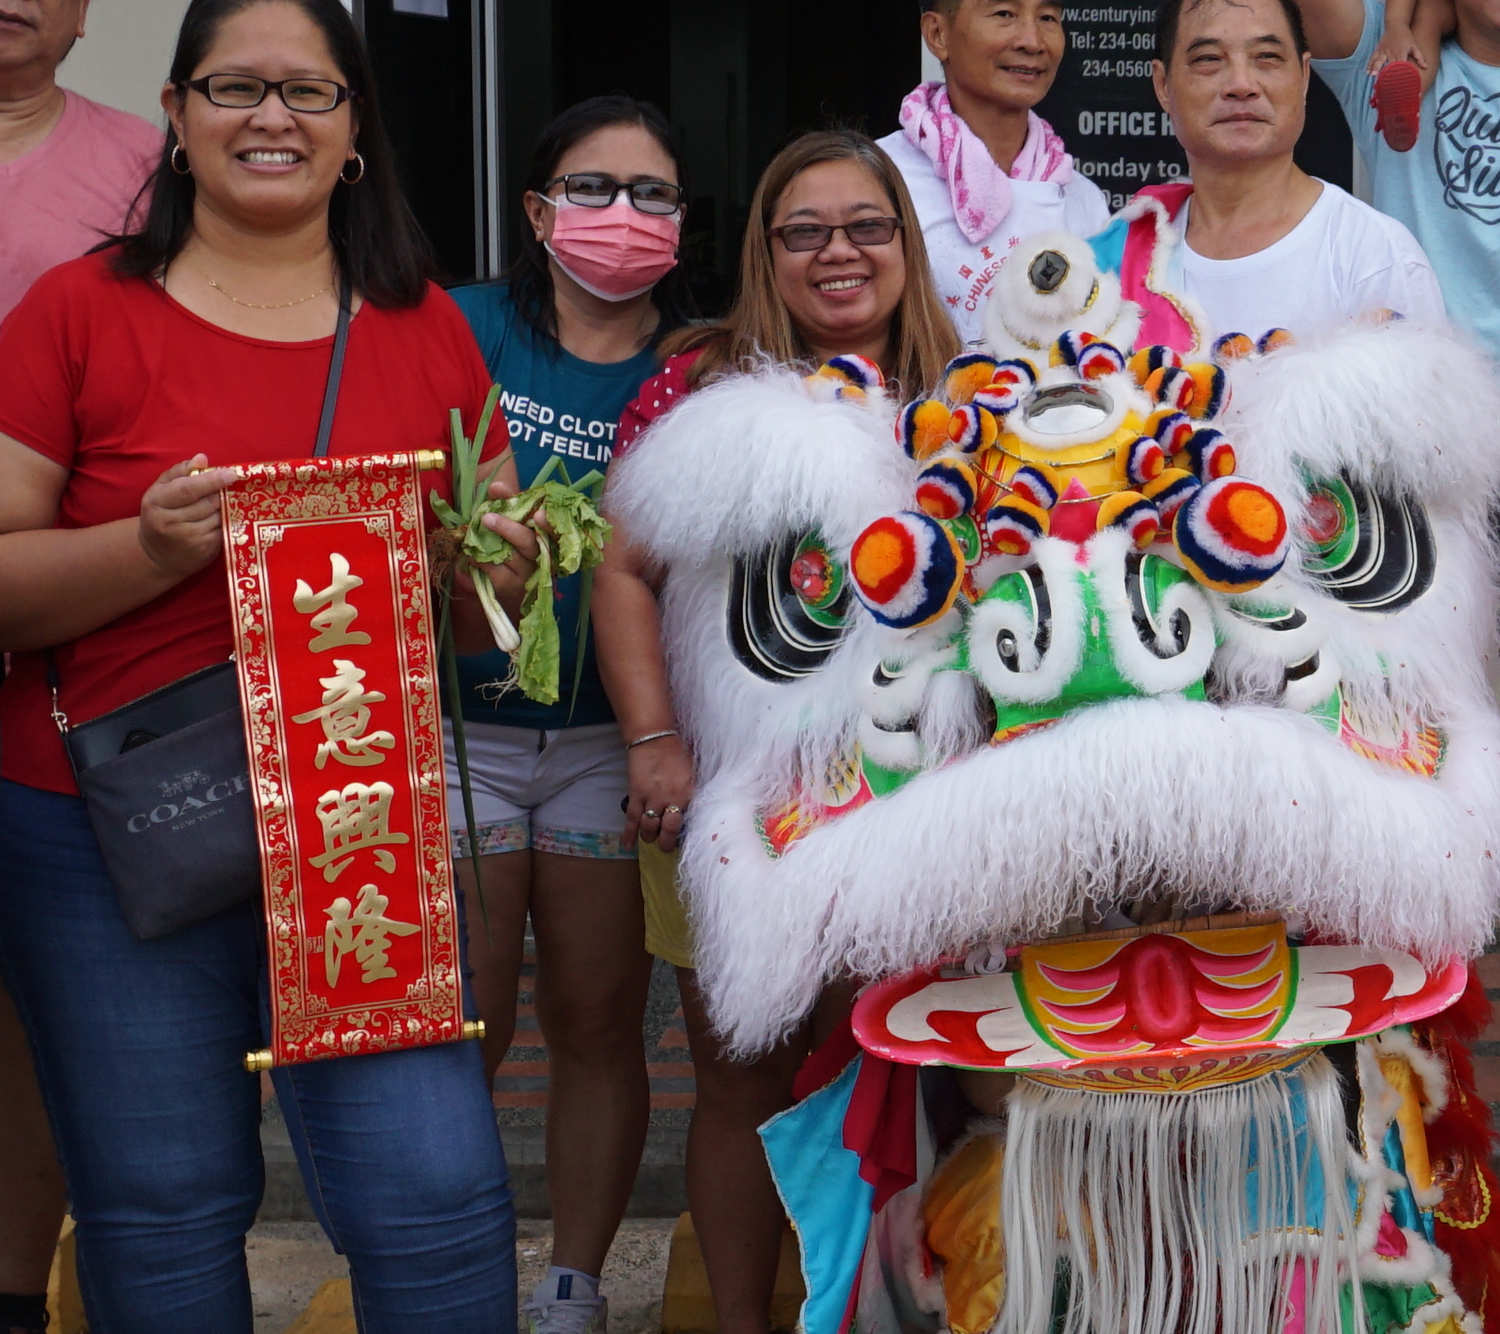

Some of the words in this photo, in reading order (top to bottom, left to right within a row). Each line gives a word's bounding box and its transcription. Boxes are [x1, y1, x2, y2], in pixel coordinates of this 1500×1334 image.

[1069, 31, 1095, 49] Tel:
[1082, 60, 1153, 78] 234-0560
[1078, 110, 1156, 136] OFFICE
[1157, 160, 1181, 178] to
[500, 390, 555, 425] NEED
[559, 414, 618, 441] CLOT
[504, 415, 537, 442] OT
[539, 430, 613, 463] FEELIN
[291, 551, 421, 990] 生意興隆
[171, 819, 196, 833] NEW
[198, 805, 226, 822] YORK
